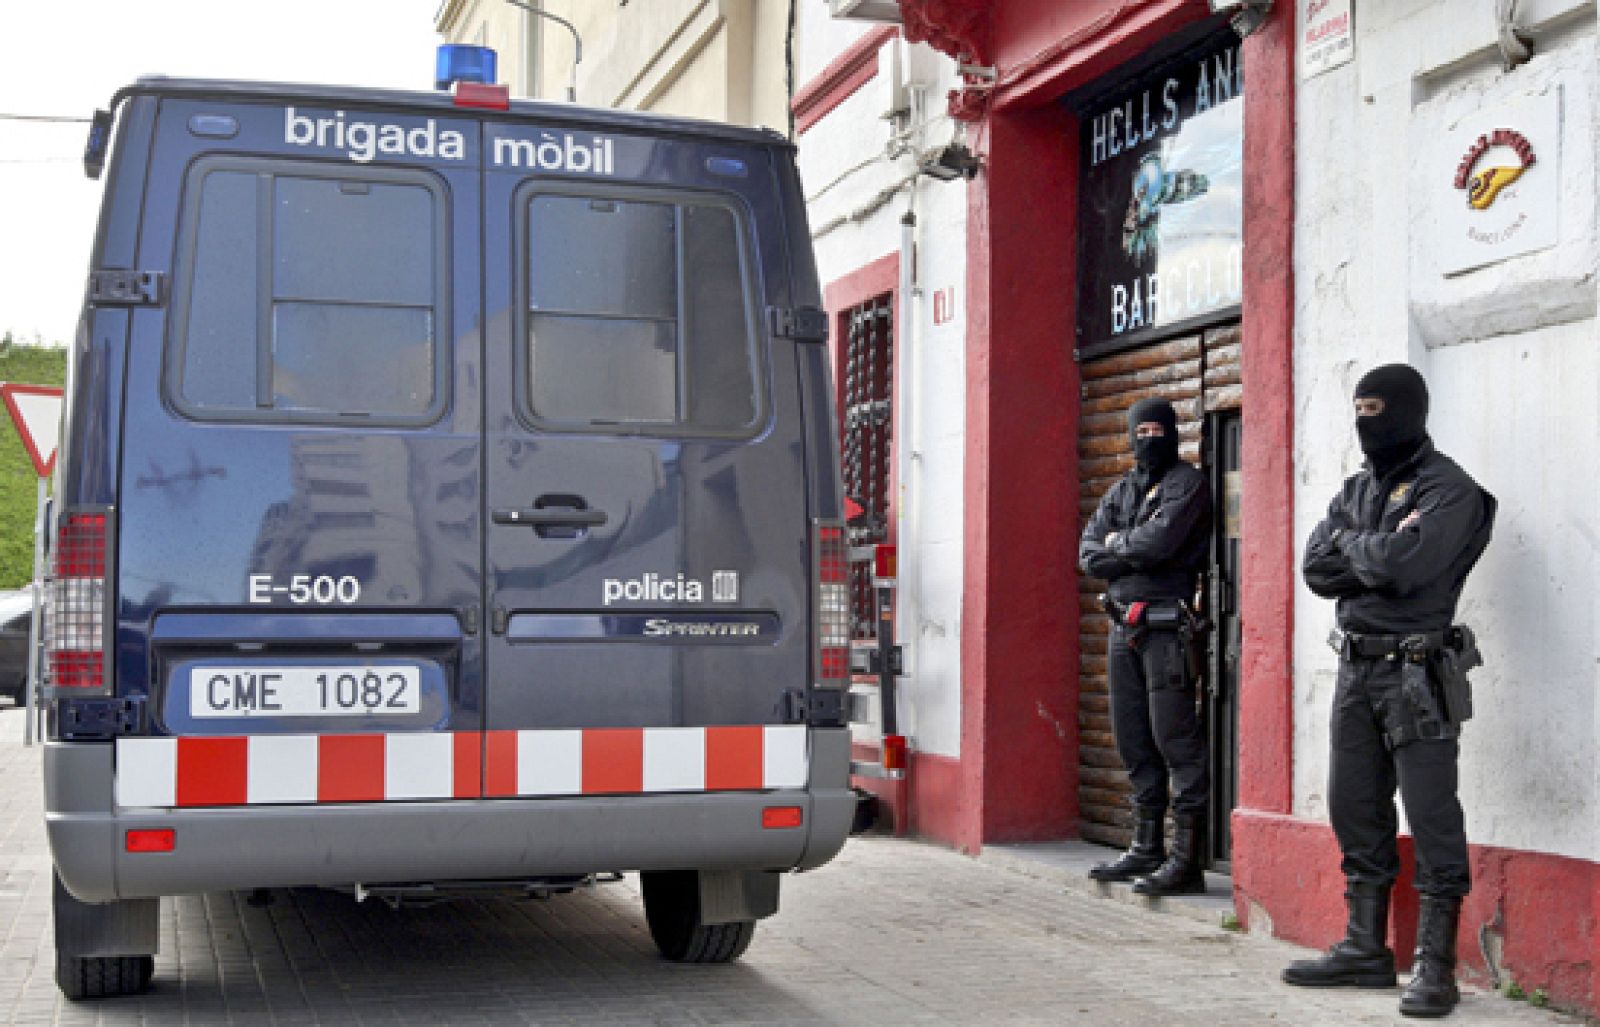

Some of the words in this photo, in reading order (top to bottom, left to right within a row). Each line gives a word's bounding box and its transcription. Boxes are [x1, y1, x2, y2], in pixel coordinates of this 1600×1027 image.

[284, 105, 466, 164] brigada
[493, 130, 615, 176] mòbil
[1092, 78, 1179, 166] HELLS
[249, 575, 361, 604] E-500
[603, 572, 703, 606] policia
[207, 673, 283, 711] CME
[316, 672, 408, 709] 1082
